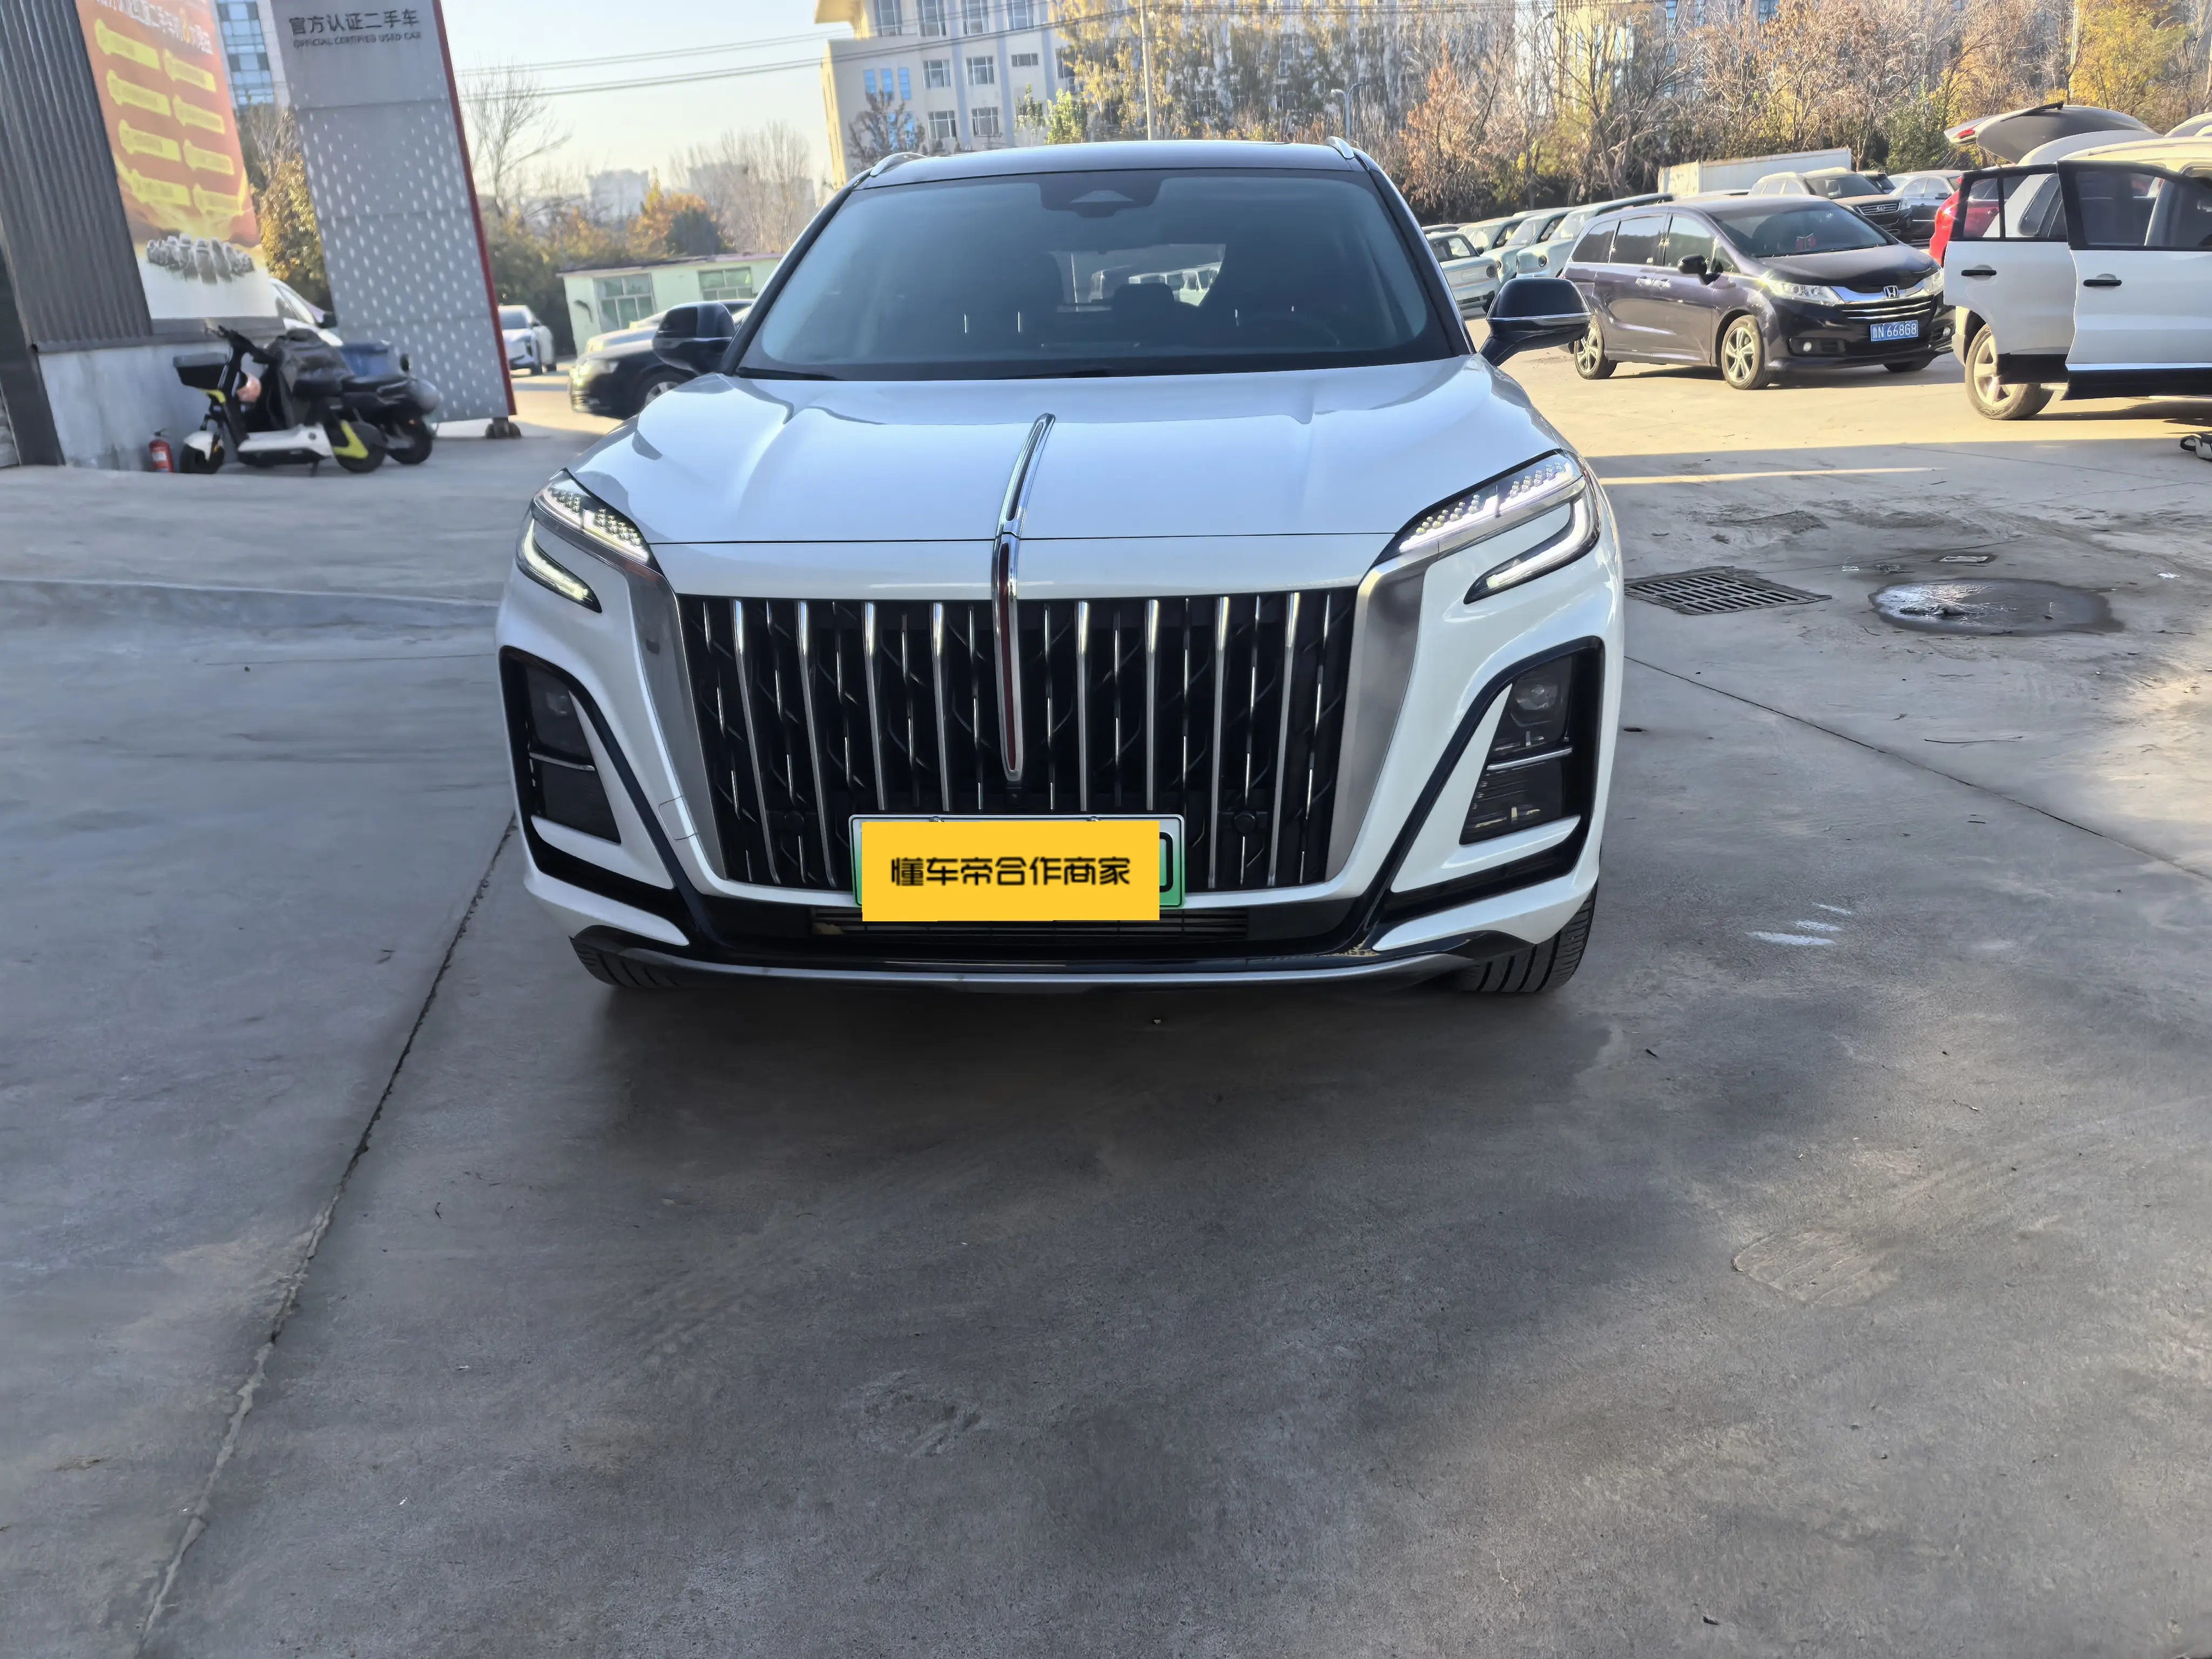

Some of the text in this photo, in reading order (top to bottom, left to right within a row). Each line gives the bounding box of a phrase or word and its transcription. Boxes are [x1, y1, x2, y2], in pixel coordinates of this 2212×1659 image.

[289, 9, 420, 36] 官方认证二手车
[404, 31, 422, 40] CAR
